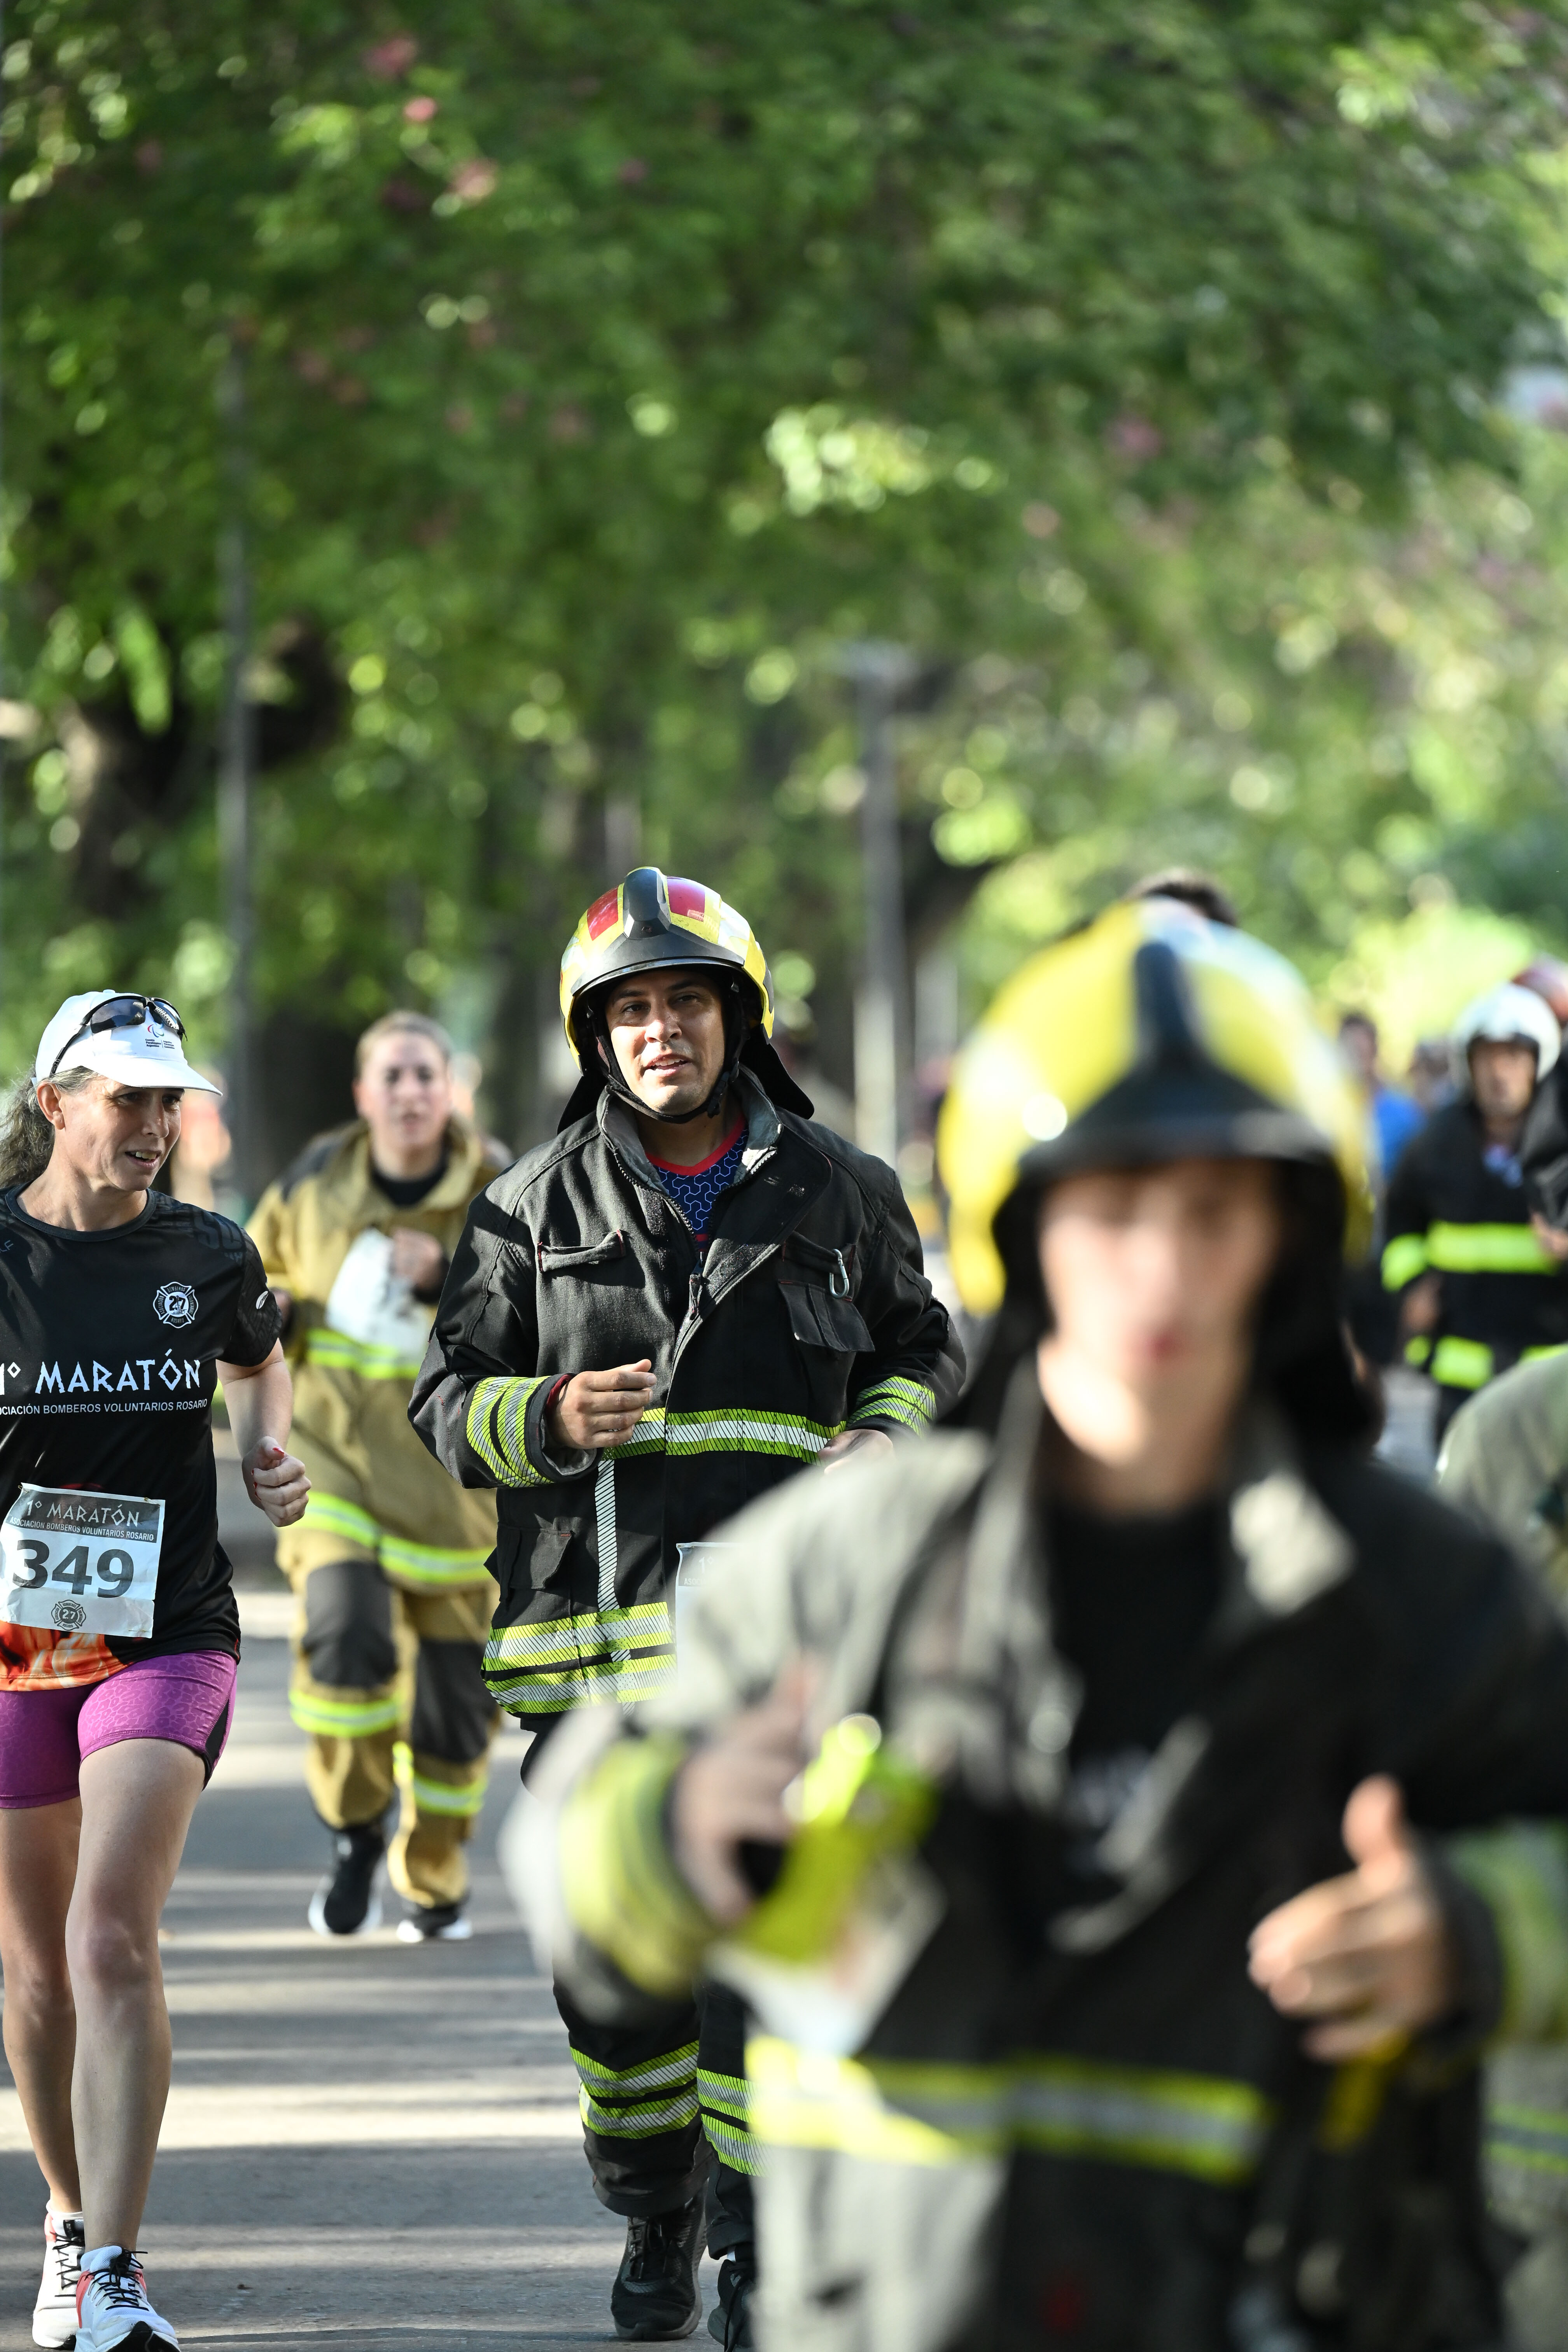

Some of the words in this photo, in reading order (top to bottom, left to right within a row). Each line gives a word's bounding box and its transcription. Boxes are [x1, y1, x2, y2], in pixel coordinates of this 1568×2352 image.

[169, 1295, 186, 1311] 27
[35, 1348, 200, 1394] MARATÓN
[0, 1404, 40, 1416] CIACIÓN
[43, 1404, 101, 1414] BOMBEROS
[104, 1402, 174, 1412] VOLUNTARIOS
[176, 1398, 208, 1410] ROSARIO
[46, 1502, 140, 1528] MARATÓN
[9, 1516, 45, 1529] ASOCIACIÓN
[46, 1522, 80, 1533] BOMBEROS
[82, 1526, 124, 1538] VOLUNTARIOS
[126, 1531, 154, 1541] ROSARIO
[12, 1539, 134, 1598] 349
[62, 1609, 76, 1619] 27
